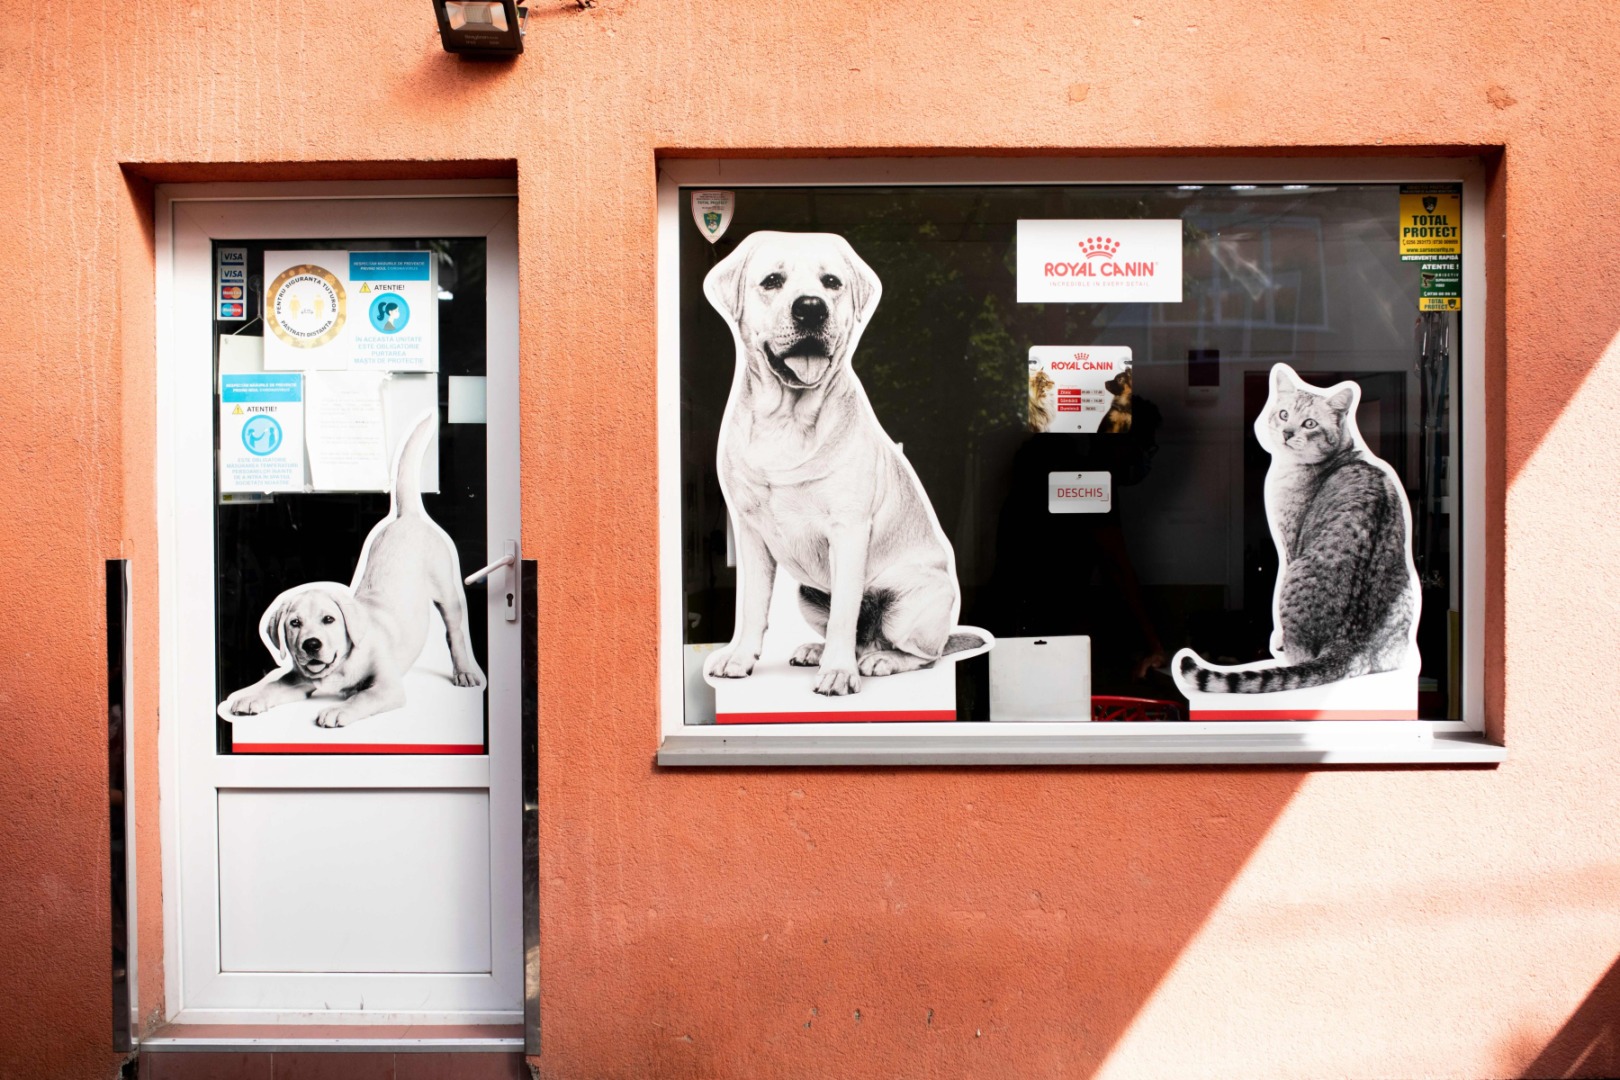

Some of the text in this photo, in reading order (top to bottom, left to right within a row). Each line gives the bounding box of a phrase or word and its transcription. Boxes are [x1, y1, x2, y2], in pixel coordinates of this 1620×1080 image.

[1412, 215, 1448, 226] TOTAL
[1403, 226, 1458, 238] PROTECT
[1044, 262, 1154, 276] ROYAL CANIN
[276, 288, 286, 314] PENTRU
[322, 282, 337, 312] TUTUROR
[1052, 362, 1112, 370] ROYAL CANIN
[1057, 488, 1103, 498] DESCHIS
